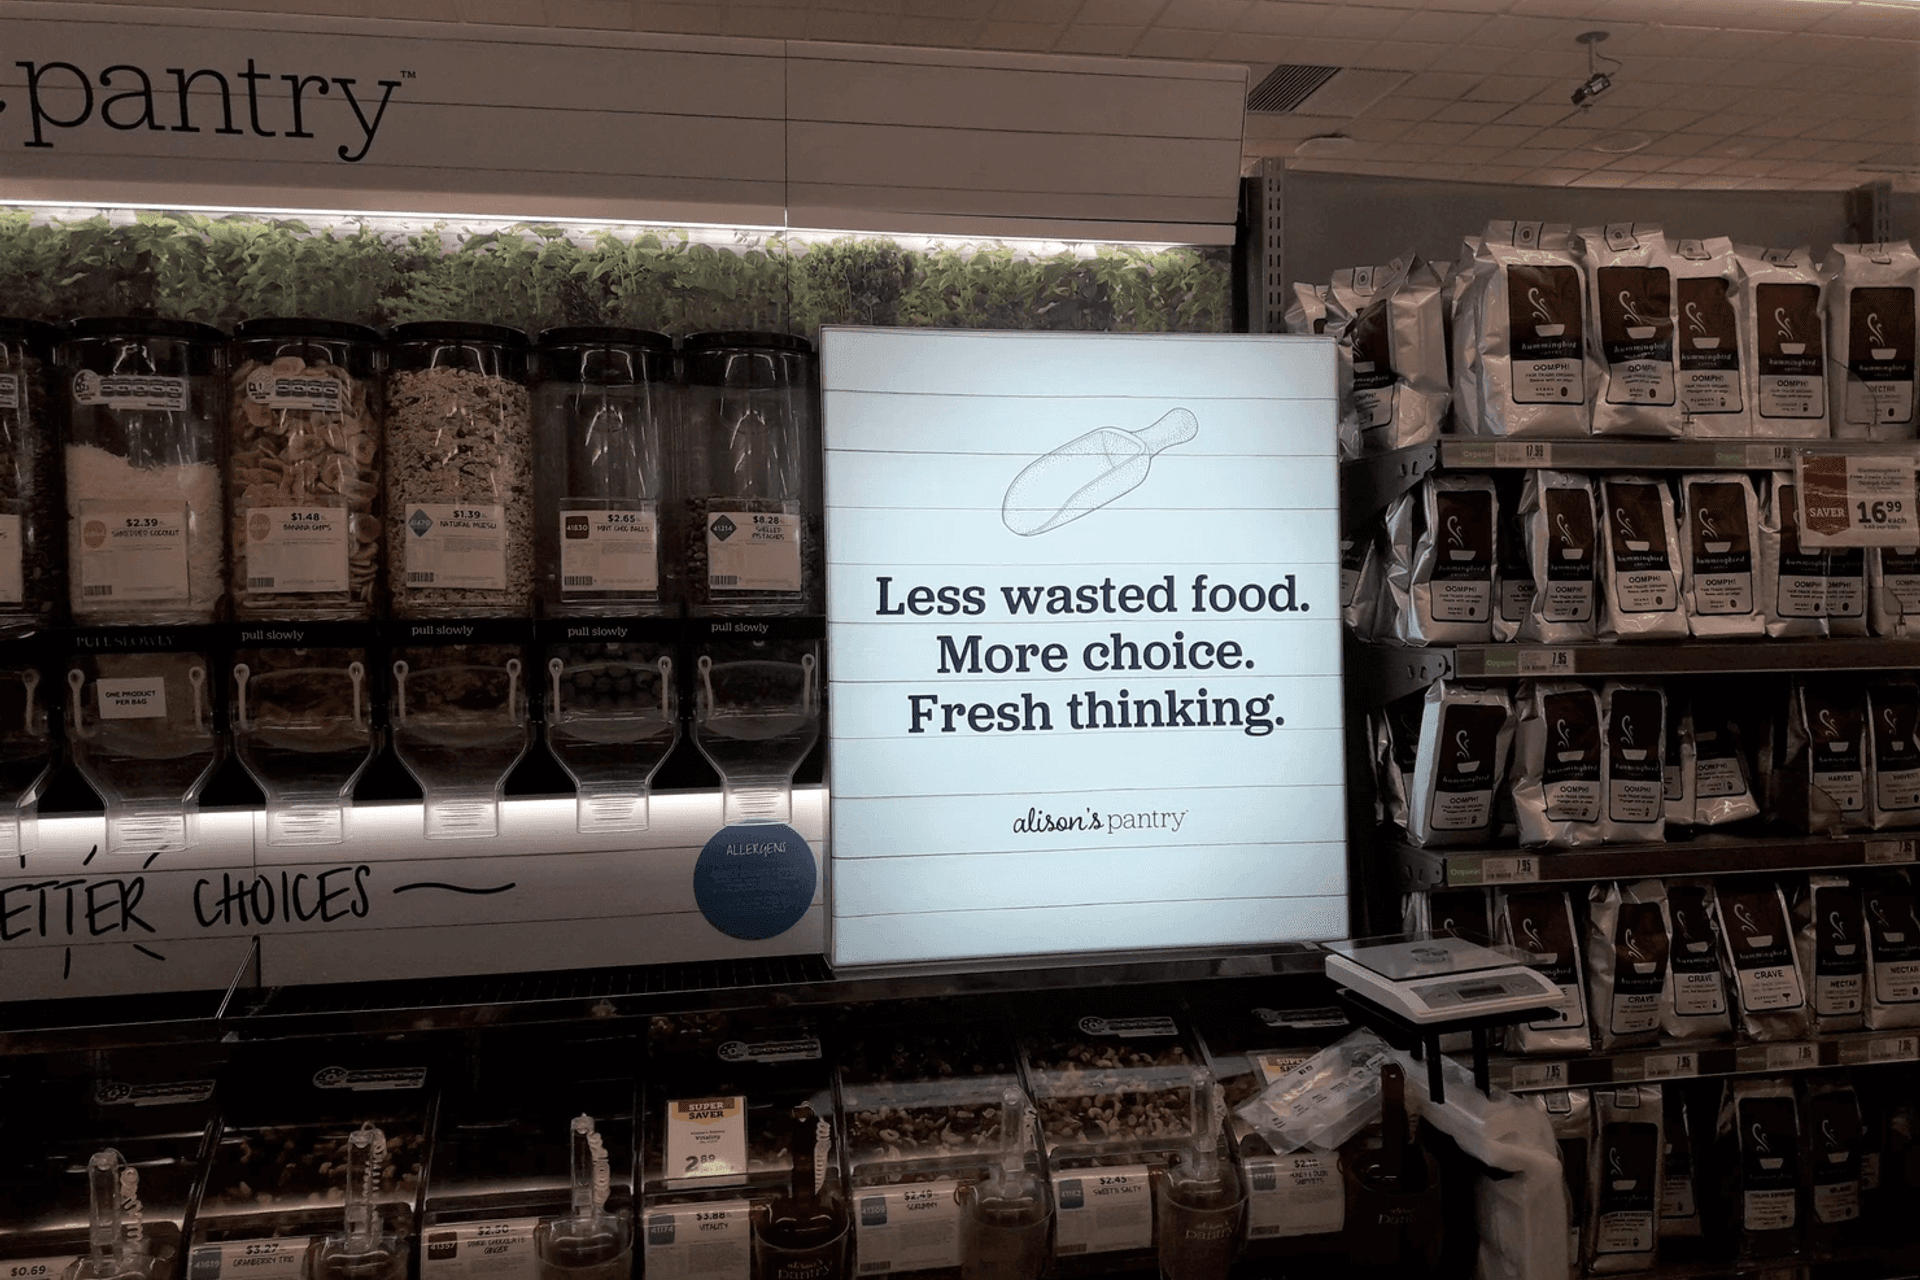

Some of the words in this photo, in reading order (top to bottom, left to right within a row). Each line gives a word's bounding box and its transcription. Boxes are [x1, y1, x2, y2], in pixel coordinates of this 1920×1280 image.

[16, 58, 401, 161] pantry
[291, 512, 321, 521] $1.48
[452, 510, 482, 519] $1.39
[1809, 508, 1847, 517] SAVER
[126, 518, 159, 528] $2.39
[607, 514, 637, 523] $2.65
[753, 515, 781, 524] $8.28
[876, 576, 985, 615] Less
[1000, 576, 1176, 615] wasted
[1190, 574, 1310, 613] food.
[412, 625, 433, 637] pull
[435, 625, 474, 637] slowly
[567, 626, 589, 638] pull
[591, 626, 628, 637] slowly
[711, 622, 732, 634] pull
[734, 622, 769, 634] slowly
[242, 630, 264, 642] pull
[265, 629, 305, 641] slowly
[936, 635, 1068, 674] More
[1083, 631, 1255, 671] choice.
[121, 690, 156, 698] PRODUCT
[908, 693, 1053, 733] Fresh
[1066, 688, 1285, 736] thinking.
[1013, 807, 1105, 834] alison's
[1106, 809, 1186, 835] pantry
[194, 865, 371, 927] CHOICES
[1688, 973, 1714, 982] CRAVE
[1754, 969, 1785, 979] CRAVE
[1628, 995, 1655, 1003] CRAVE
[689, 1102, 724, 1111] SUPER
[689, 1111, 724, 1120] SAVER
[699, 1222, 729, 1231] VITALITY
[246, 1243, 280, 1255] $3.27
[11, 1265, 47, 1277] $0.69
